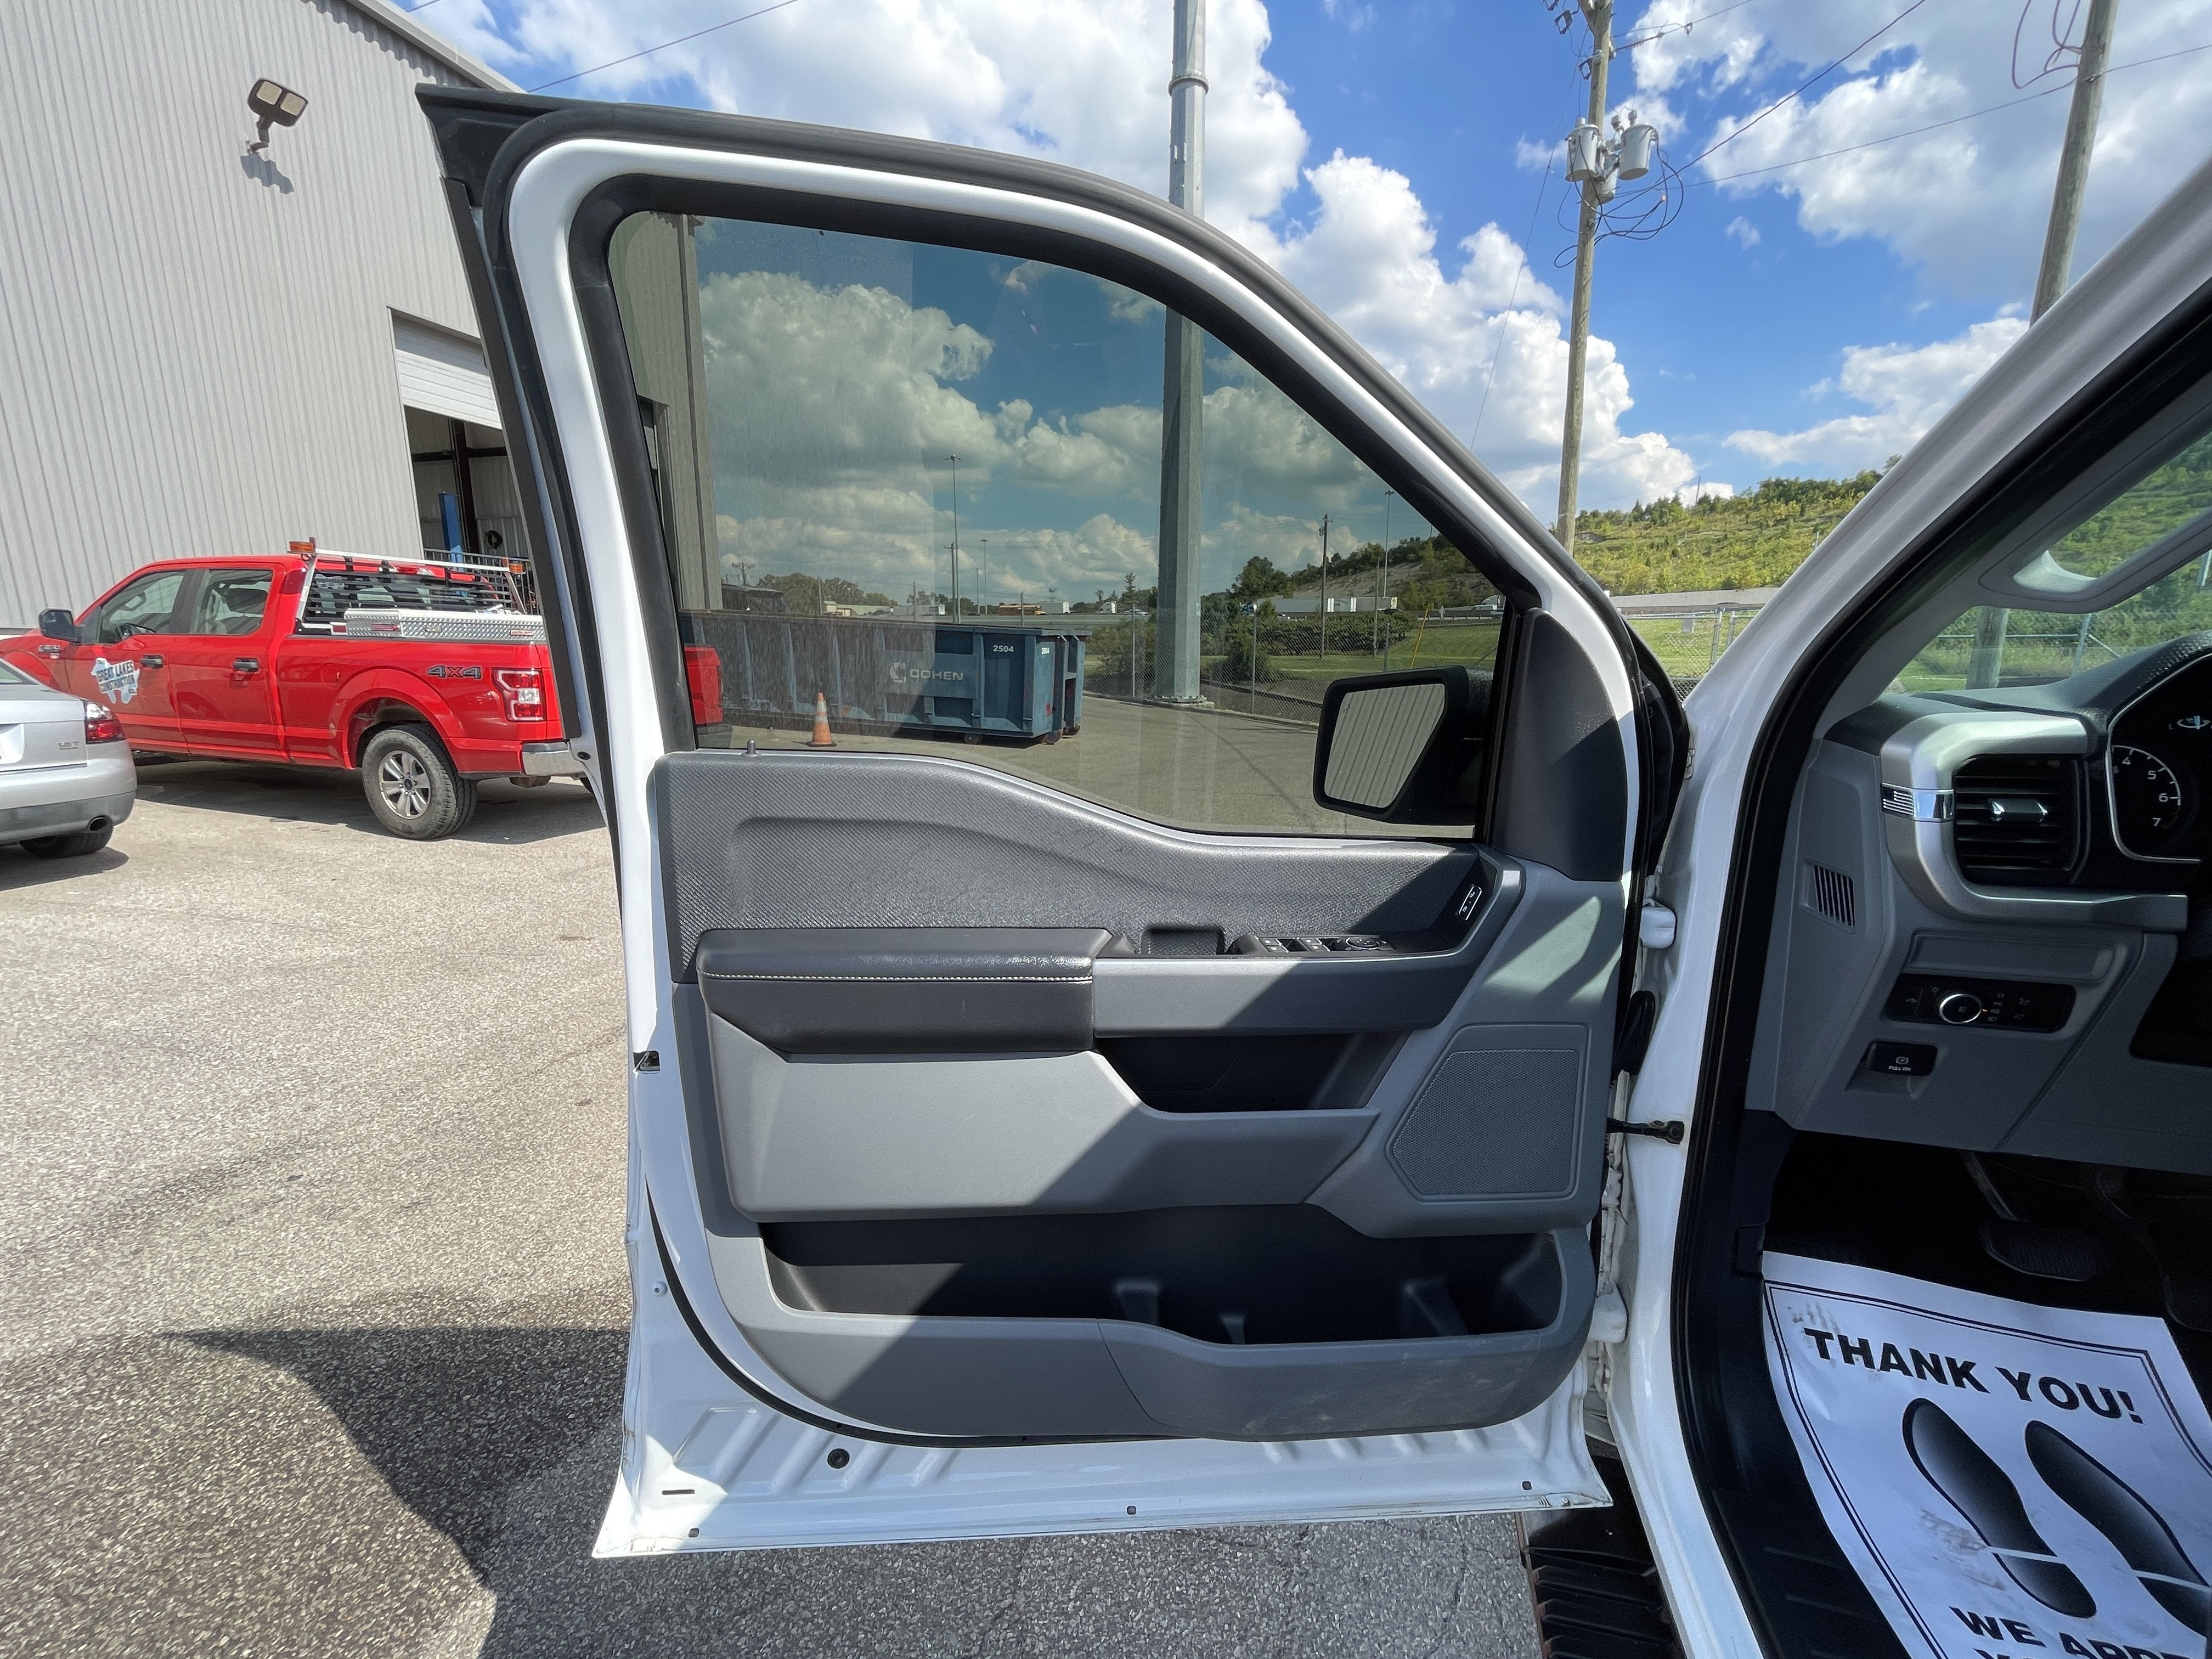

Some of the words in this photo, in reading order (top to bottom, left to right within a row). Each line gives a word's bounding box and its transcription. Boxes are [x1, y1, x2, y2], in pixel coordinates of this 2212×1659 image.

[992, 645, 1014, 653] 2504
[97, 667, 113, 682] GREAT
[115, 661, 134, 676] LAKES
[2121, 757, 2132, 766] 4
[2147, 770, 2157, 780] 5
[2158, 793, 2169, 803] 6
[2152, 817, 2162, 827] 7
[1803, 1327, 1991, 1395] THANK
[1994, 1365, 2145, 1425] YOU!
[1949, 1606, 2047, 1648] WE
